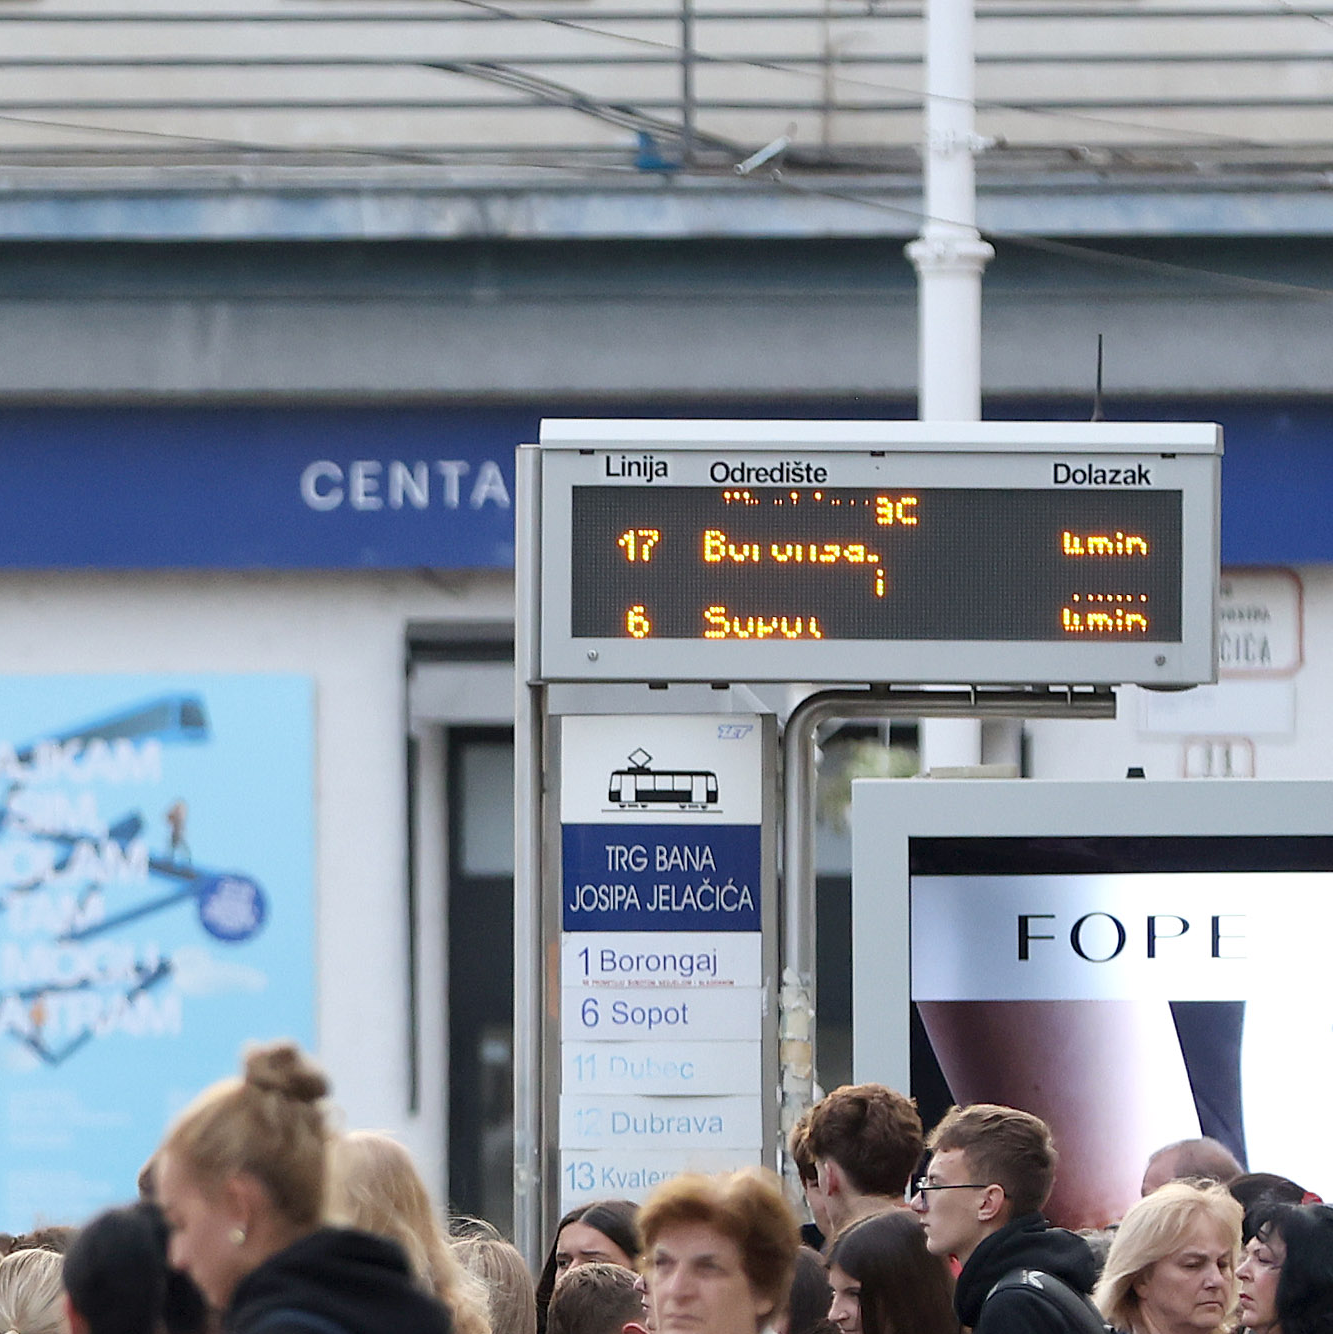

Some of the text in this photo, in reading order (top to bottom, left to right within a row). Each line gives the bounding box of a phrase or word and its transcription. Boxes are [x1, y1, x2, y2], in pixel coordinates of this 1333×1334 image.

[604, 455, 670, 479] Linija
[709, 459, 828, 484] Odredište
[1052, 462, 1152, 487] Dolazak
[299, 459, 511, 512] CENTA
[618, 529, 662, 562] 17
[625, 605, 651, 639] 6
[605, 845, 717, 872] TRG BANA
[569, 877, 755, 913] JOSIPA JELAČIĆA
[1017, 911, 1248, 963] FOPE
[577, 946, 719, 978] 1 Borongaj
[581, 997, 690, 1030] 6 Sopot
[572, 1052, 695, 1081] 11 Dubec
[611, 1108, 725, 1135] Dubrava
[565, 1161, 596, 1191] 13
